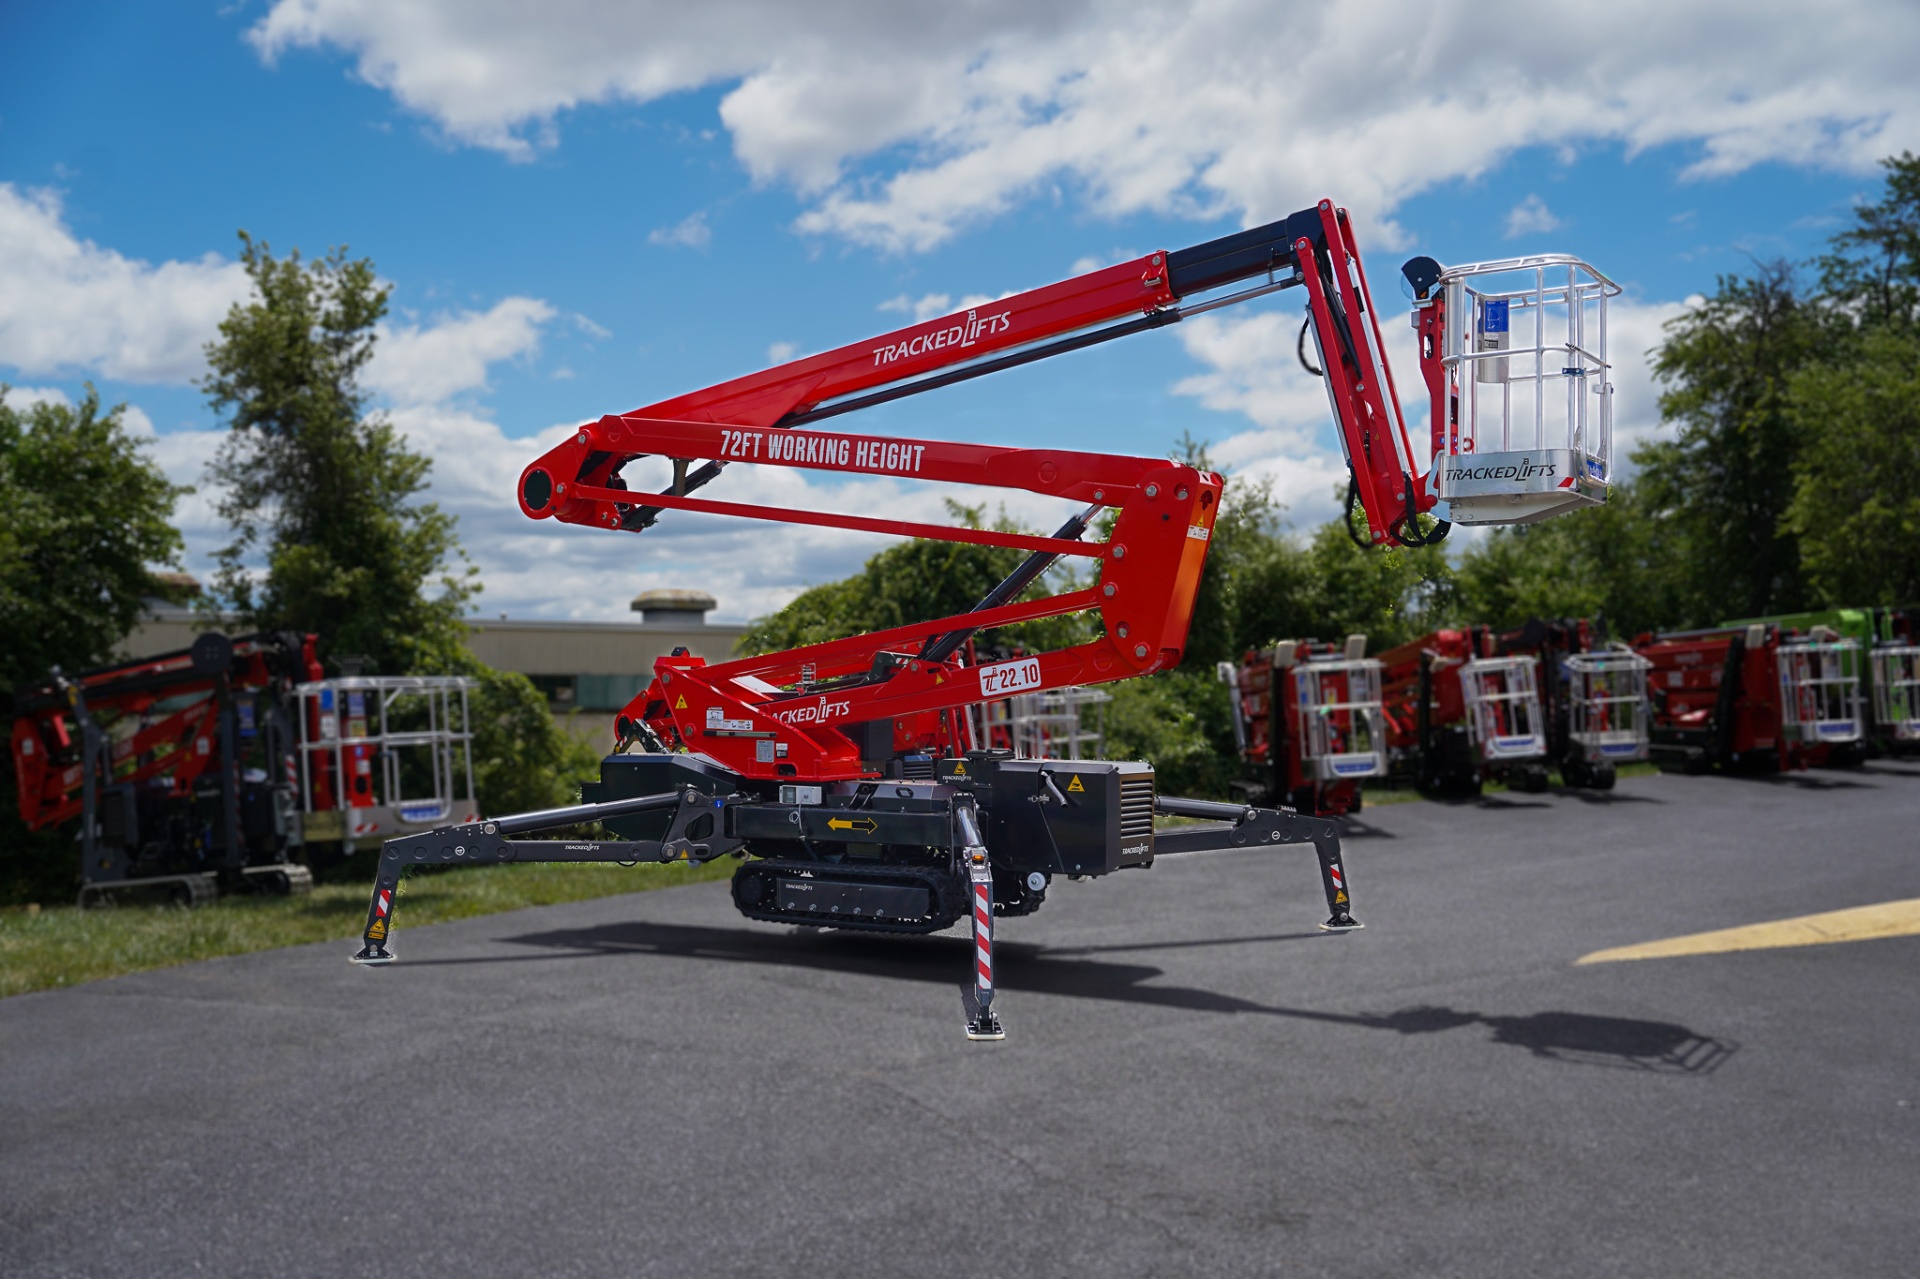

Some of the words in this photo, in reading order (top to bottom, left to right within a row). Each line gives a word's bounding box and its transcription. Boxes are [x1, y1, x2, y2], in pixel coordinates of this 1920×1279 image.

[873, 310, 1011, 366] TRACKEDLIFTS
[720, 430, 763, 458] 72FT
[768, 434, 850, 466] WORKING
[856, 441, 925, 472] HEIGHT
[1445, 458, 1557, 482] TRACKEDLIFTS
[999, 663, 1039, 689] 22.10
[772, 696, 850, 724] ACKEDLIFTS
